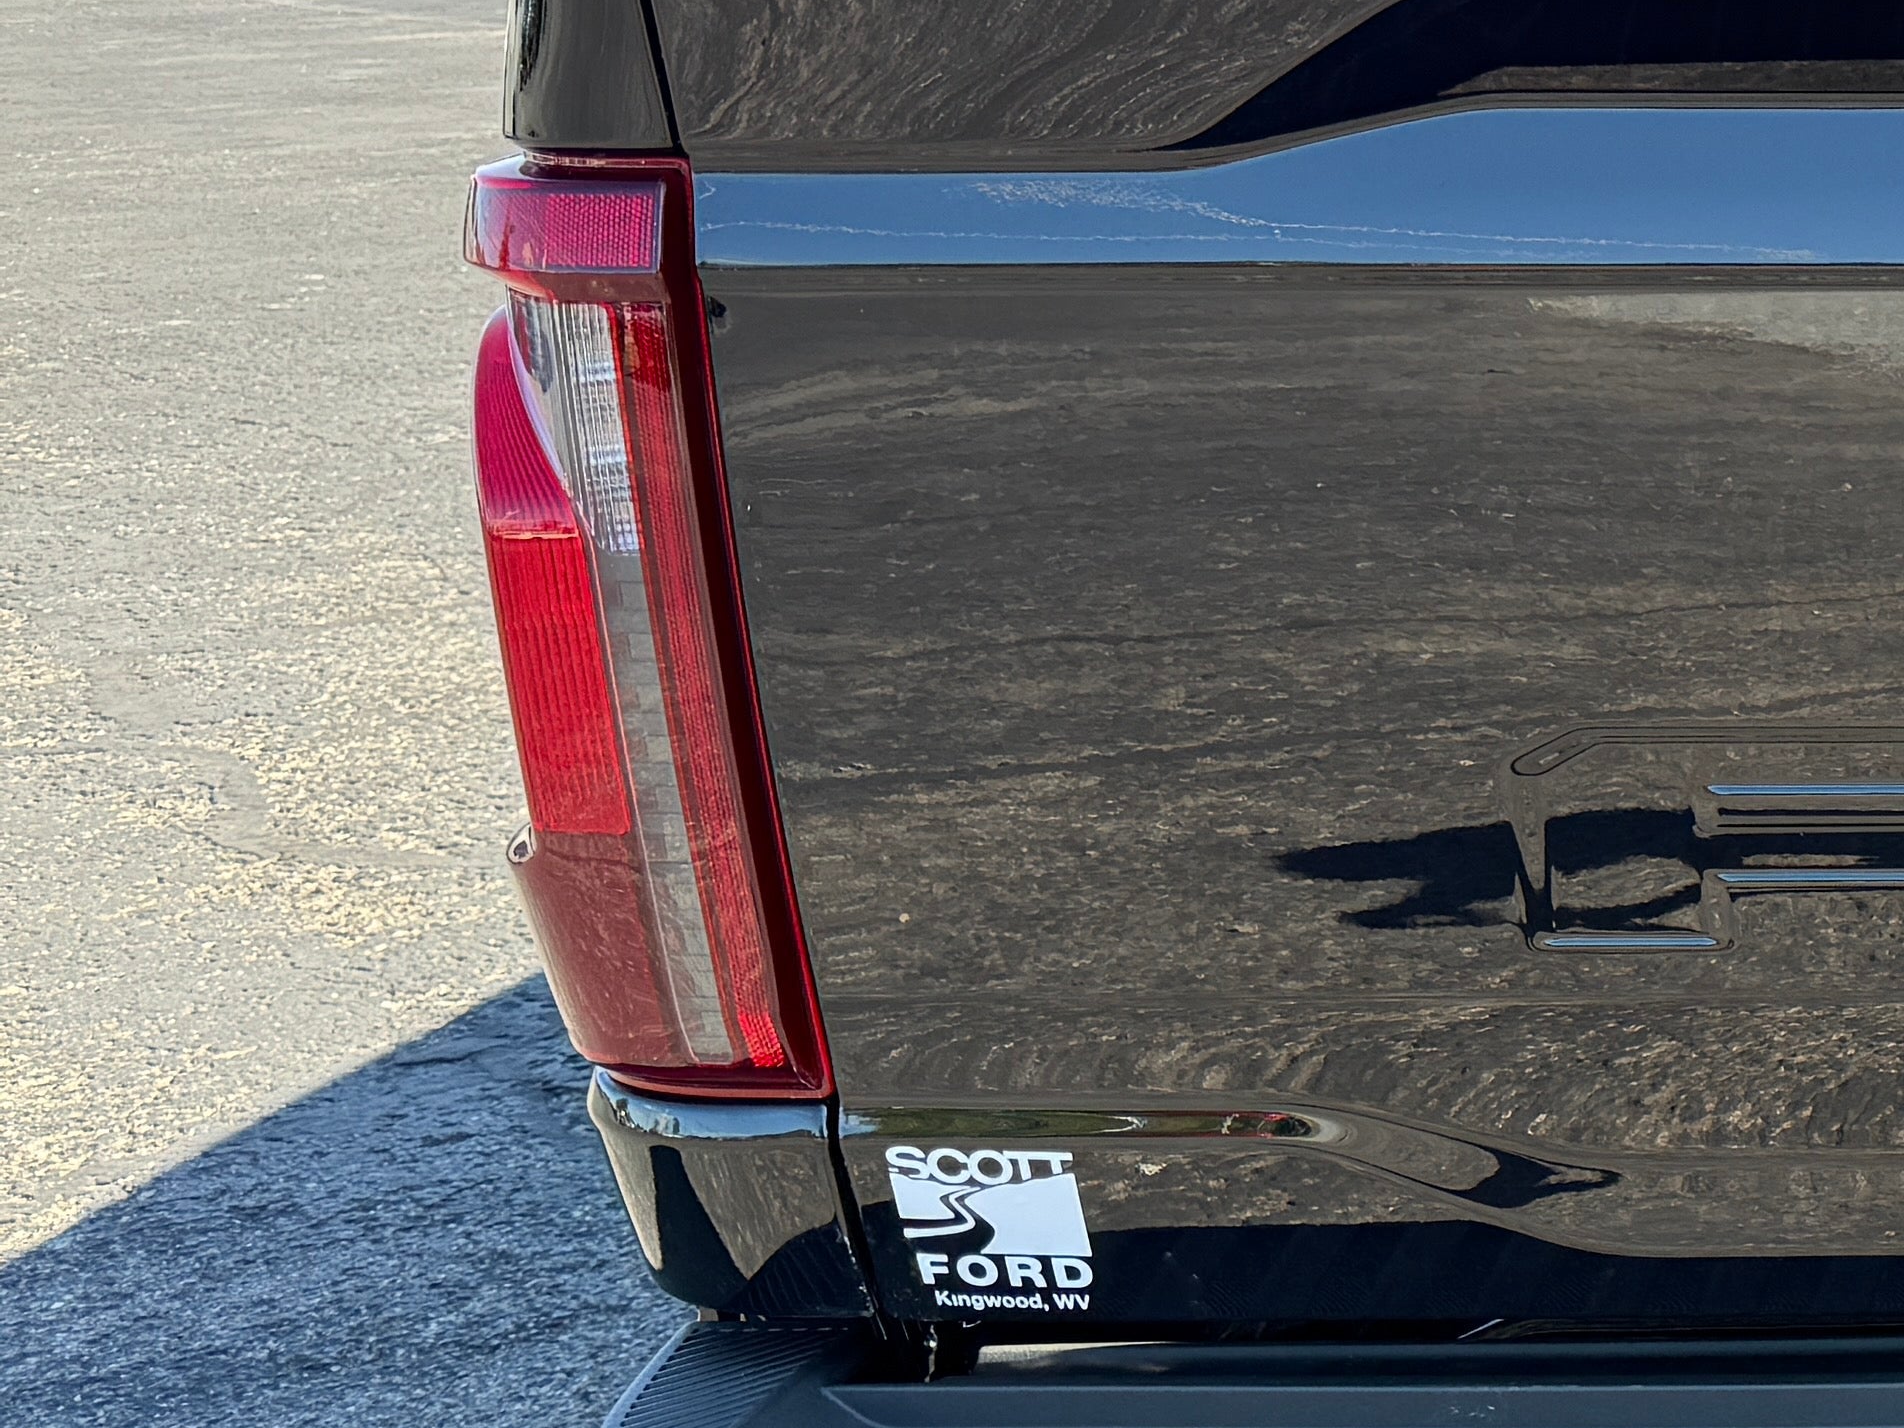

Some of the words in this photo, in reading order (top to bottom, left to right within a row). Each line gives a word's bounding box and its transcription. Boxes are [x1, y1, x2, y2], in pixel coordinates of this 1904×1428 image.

[885, 1146, 1074, 1185] SCOTT
[916, 1253, 1093, 1288] FORD
[934, 1290, 1050, 1312] Kingwood,
[1052, 1293, 1090, 1311] WV
